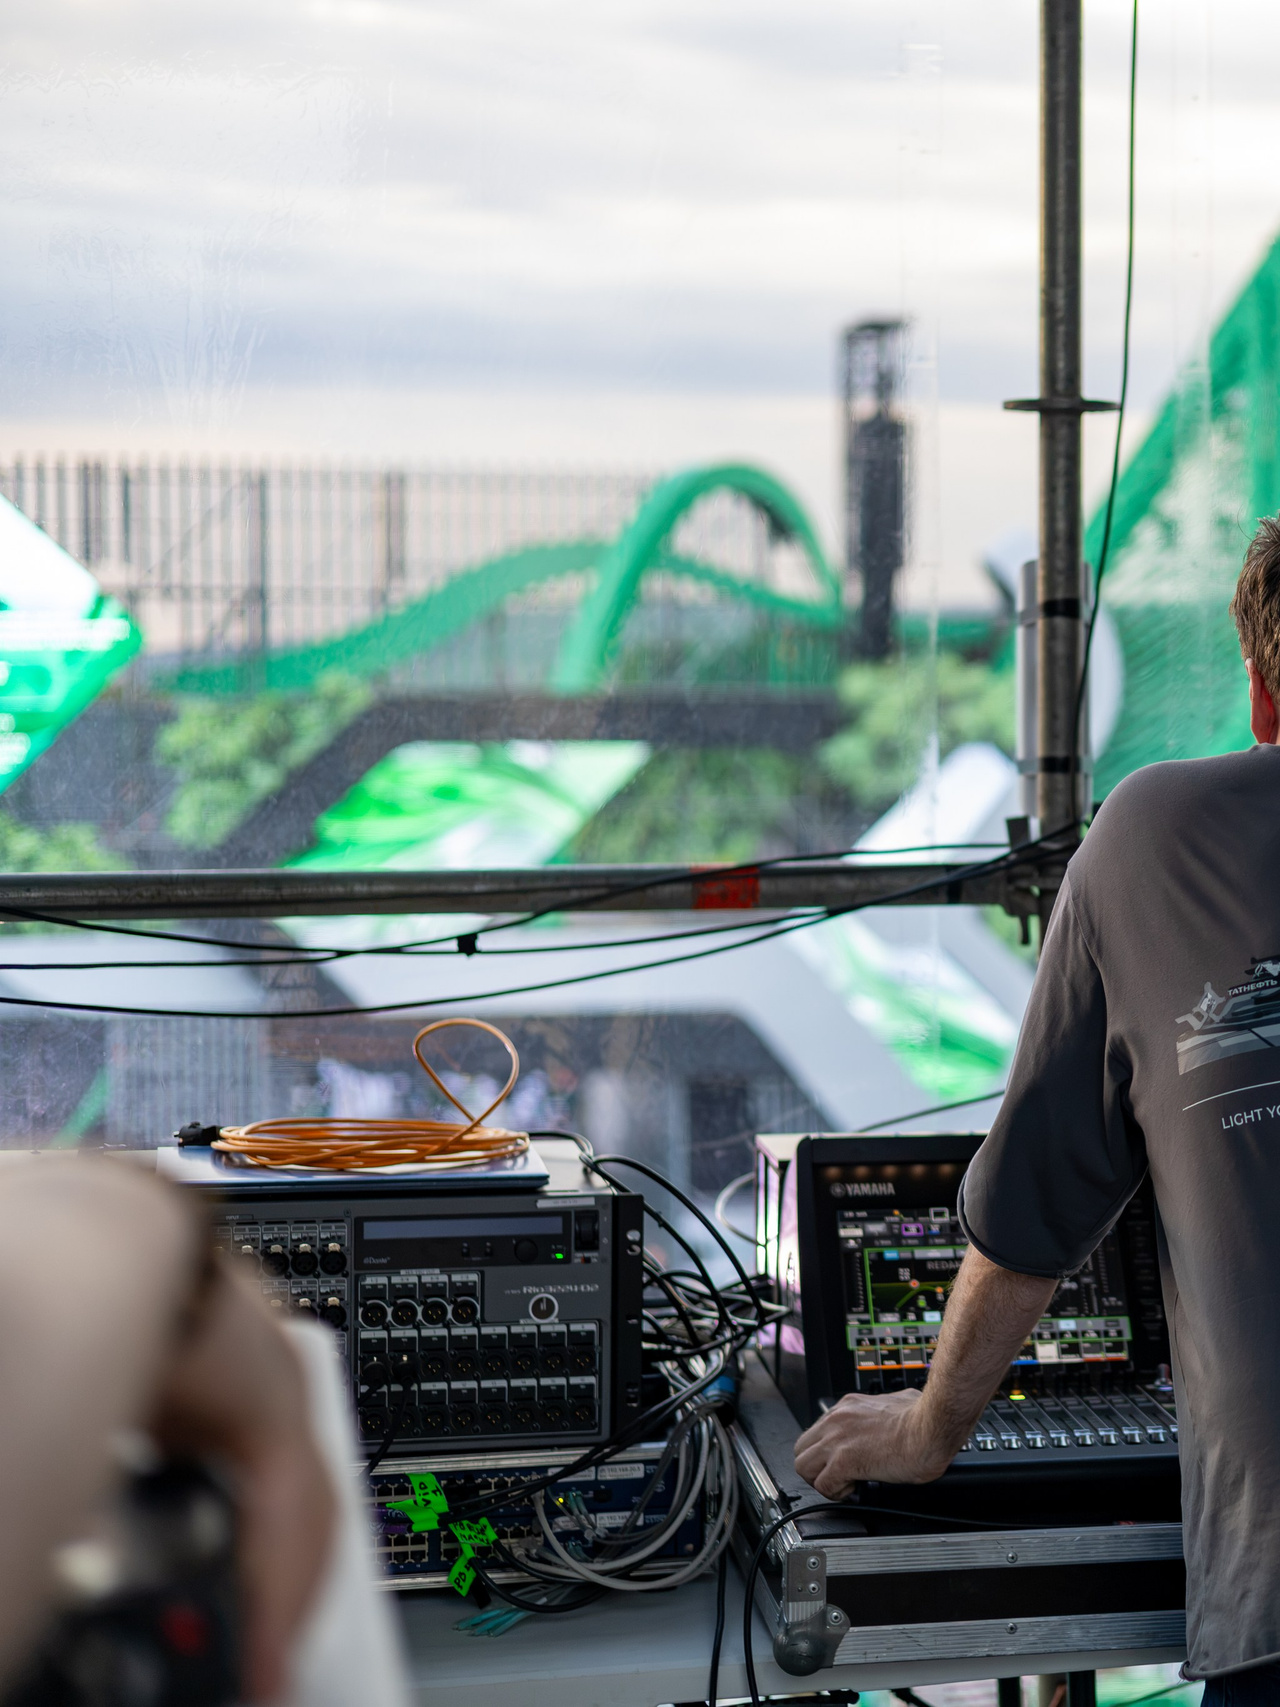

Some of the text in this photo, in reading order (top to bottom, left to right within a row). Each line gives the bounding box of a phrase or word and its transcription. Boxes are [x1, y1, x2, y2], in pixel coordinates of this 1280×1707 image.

[1227, 979, 1279, 997] ТАТНЕФТЬ
[1221, 1108, 1263, 1130] LIGHT
[845, 1182, 895, 1196] YAMAHA
